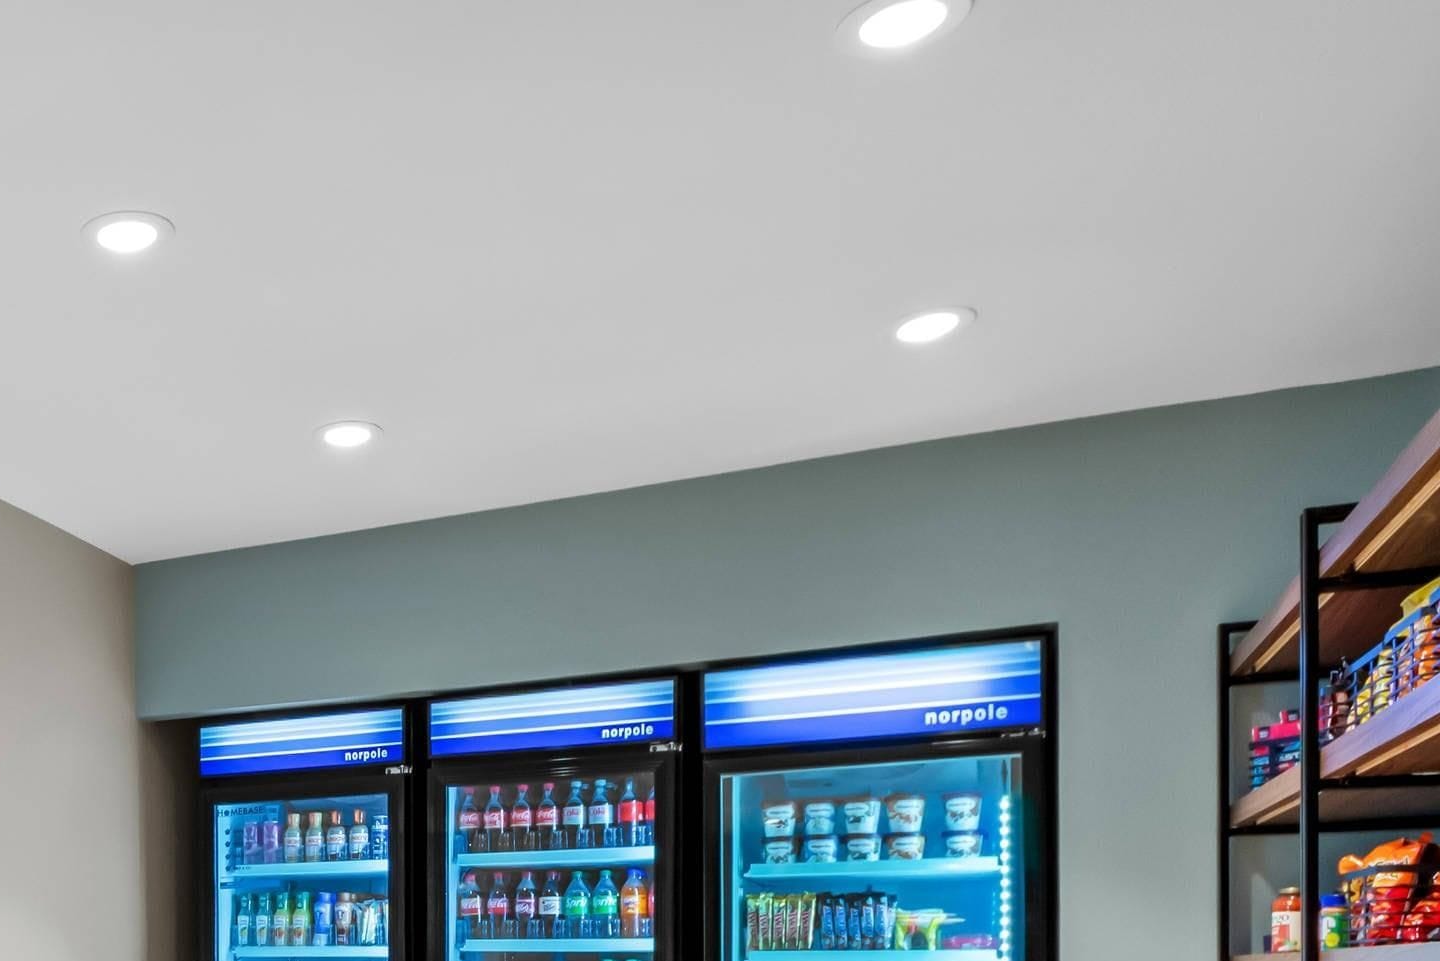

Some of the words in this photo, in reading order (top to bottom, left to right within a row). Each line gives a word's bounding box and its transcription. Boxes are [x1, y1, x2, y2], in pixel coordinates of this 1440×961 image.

[924, 704, 1008, 725] norpole
[601, 724, 653, 739] norpole
[344, 748, 388, 762] norpole
